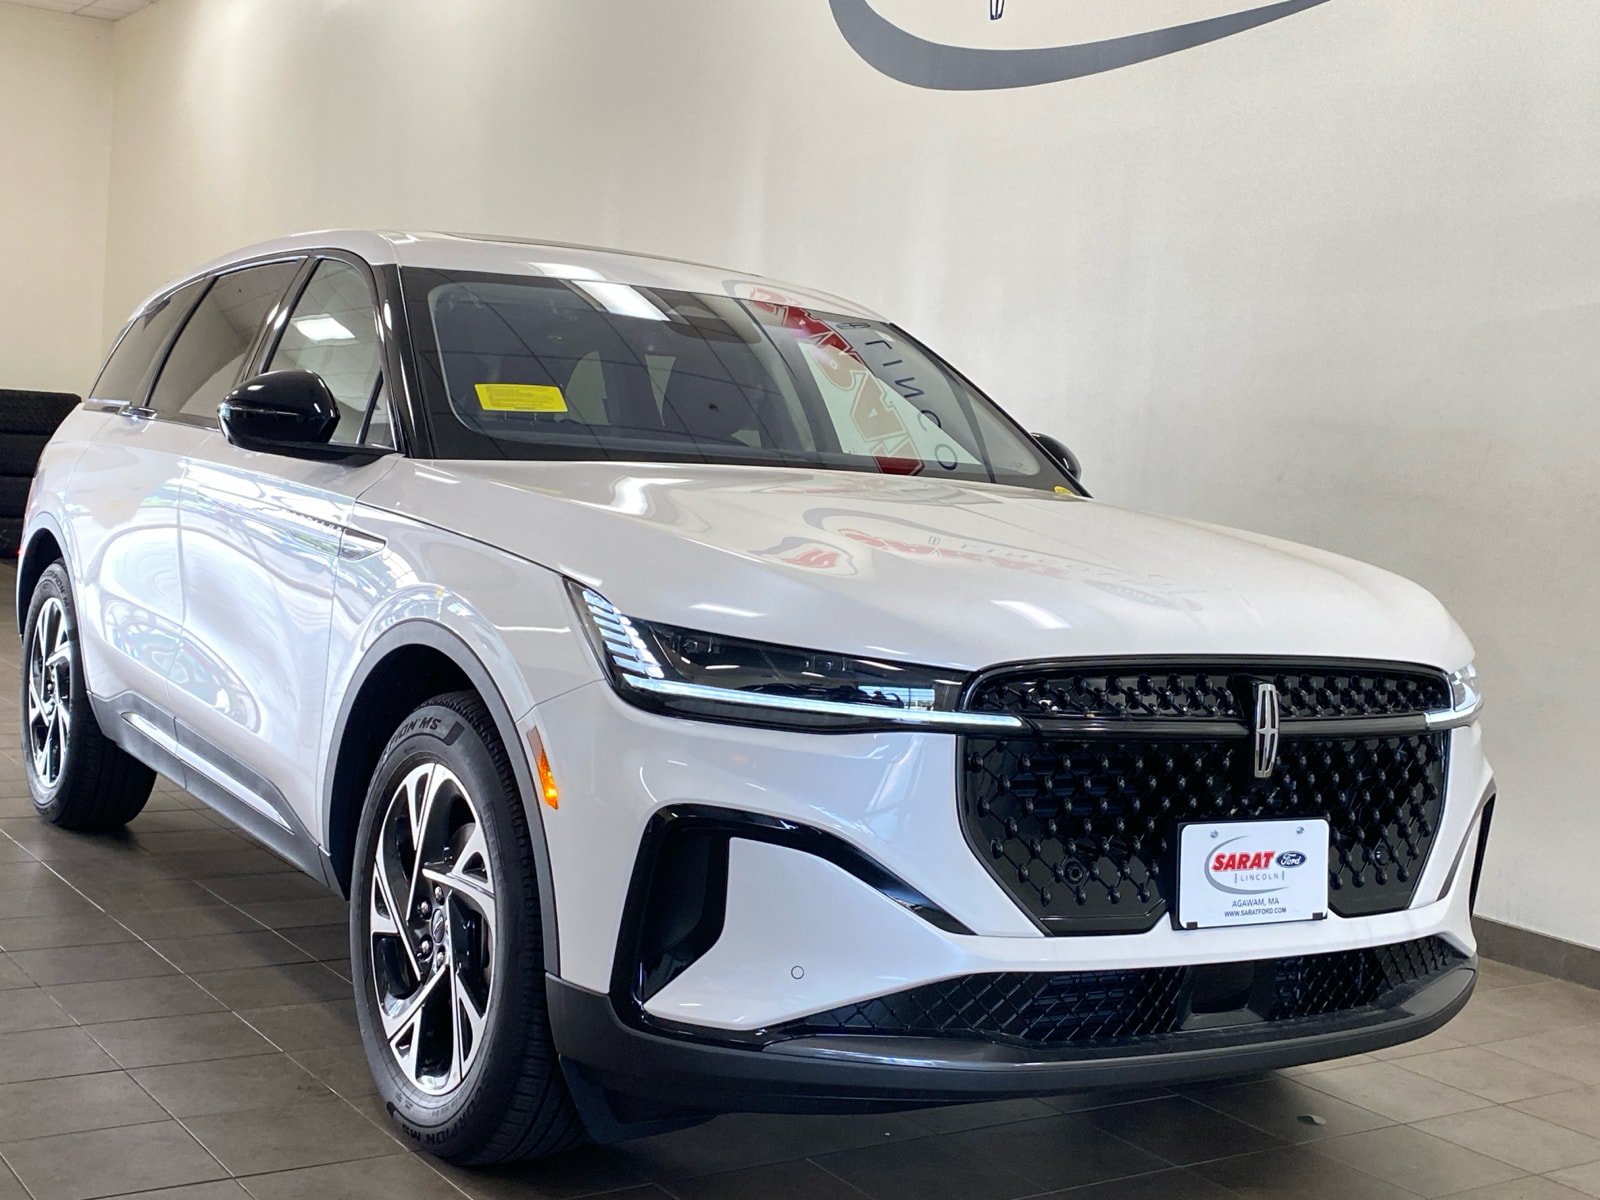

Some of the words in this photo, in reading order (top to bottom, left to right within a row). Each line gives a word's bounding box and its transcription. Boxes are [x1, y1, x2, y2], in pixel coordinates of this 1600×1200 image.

[418, 716, 442, 730] MS
[1212, 851, 1275, 871] SARAT
[1280, 853, 1302, 866] Ford
[1240, 873, 1279, 882] LINCOLN
[1232, 898, 1267, 908] AGAWAM,
[1268, 897, 1280, 906] MA
[1224, 907, 1287, 917] WWW.SARATFORD.COM
